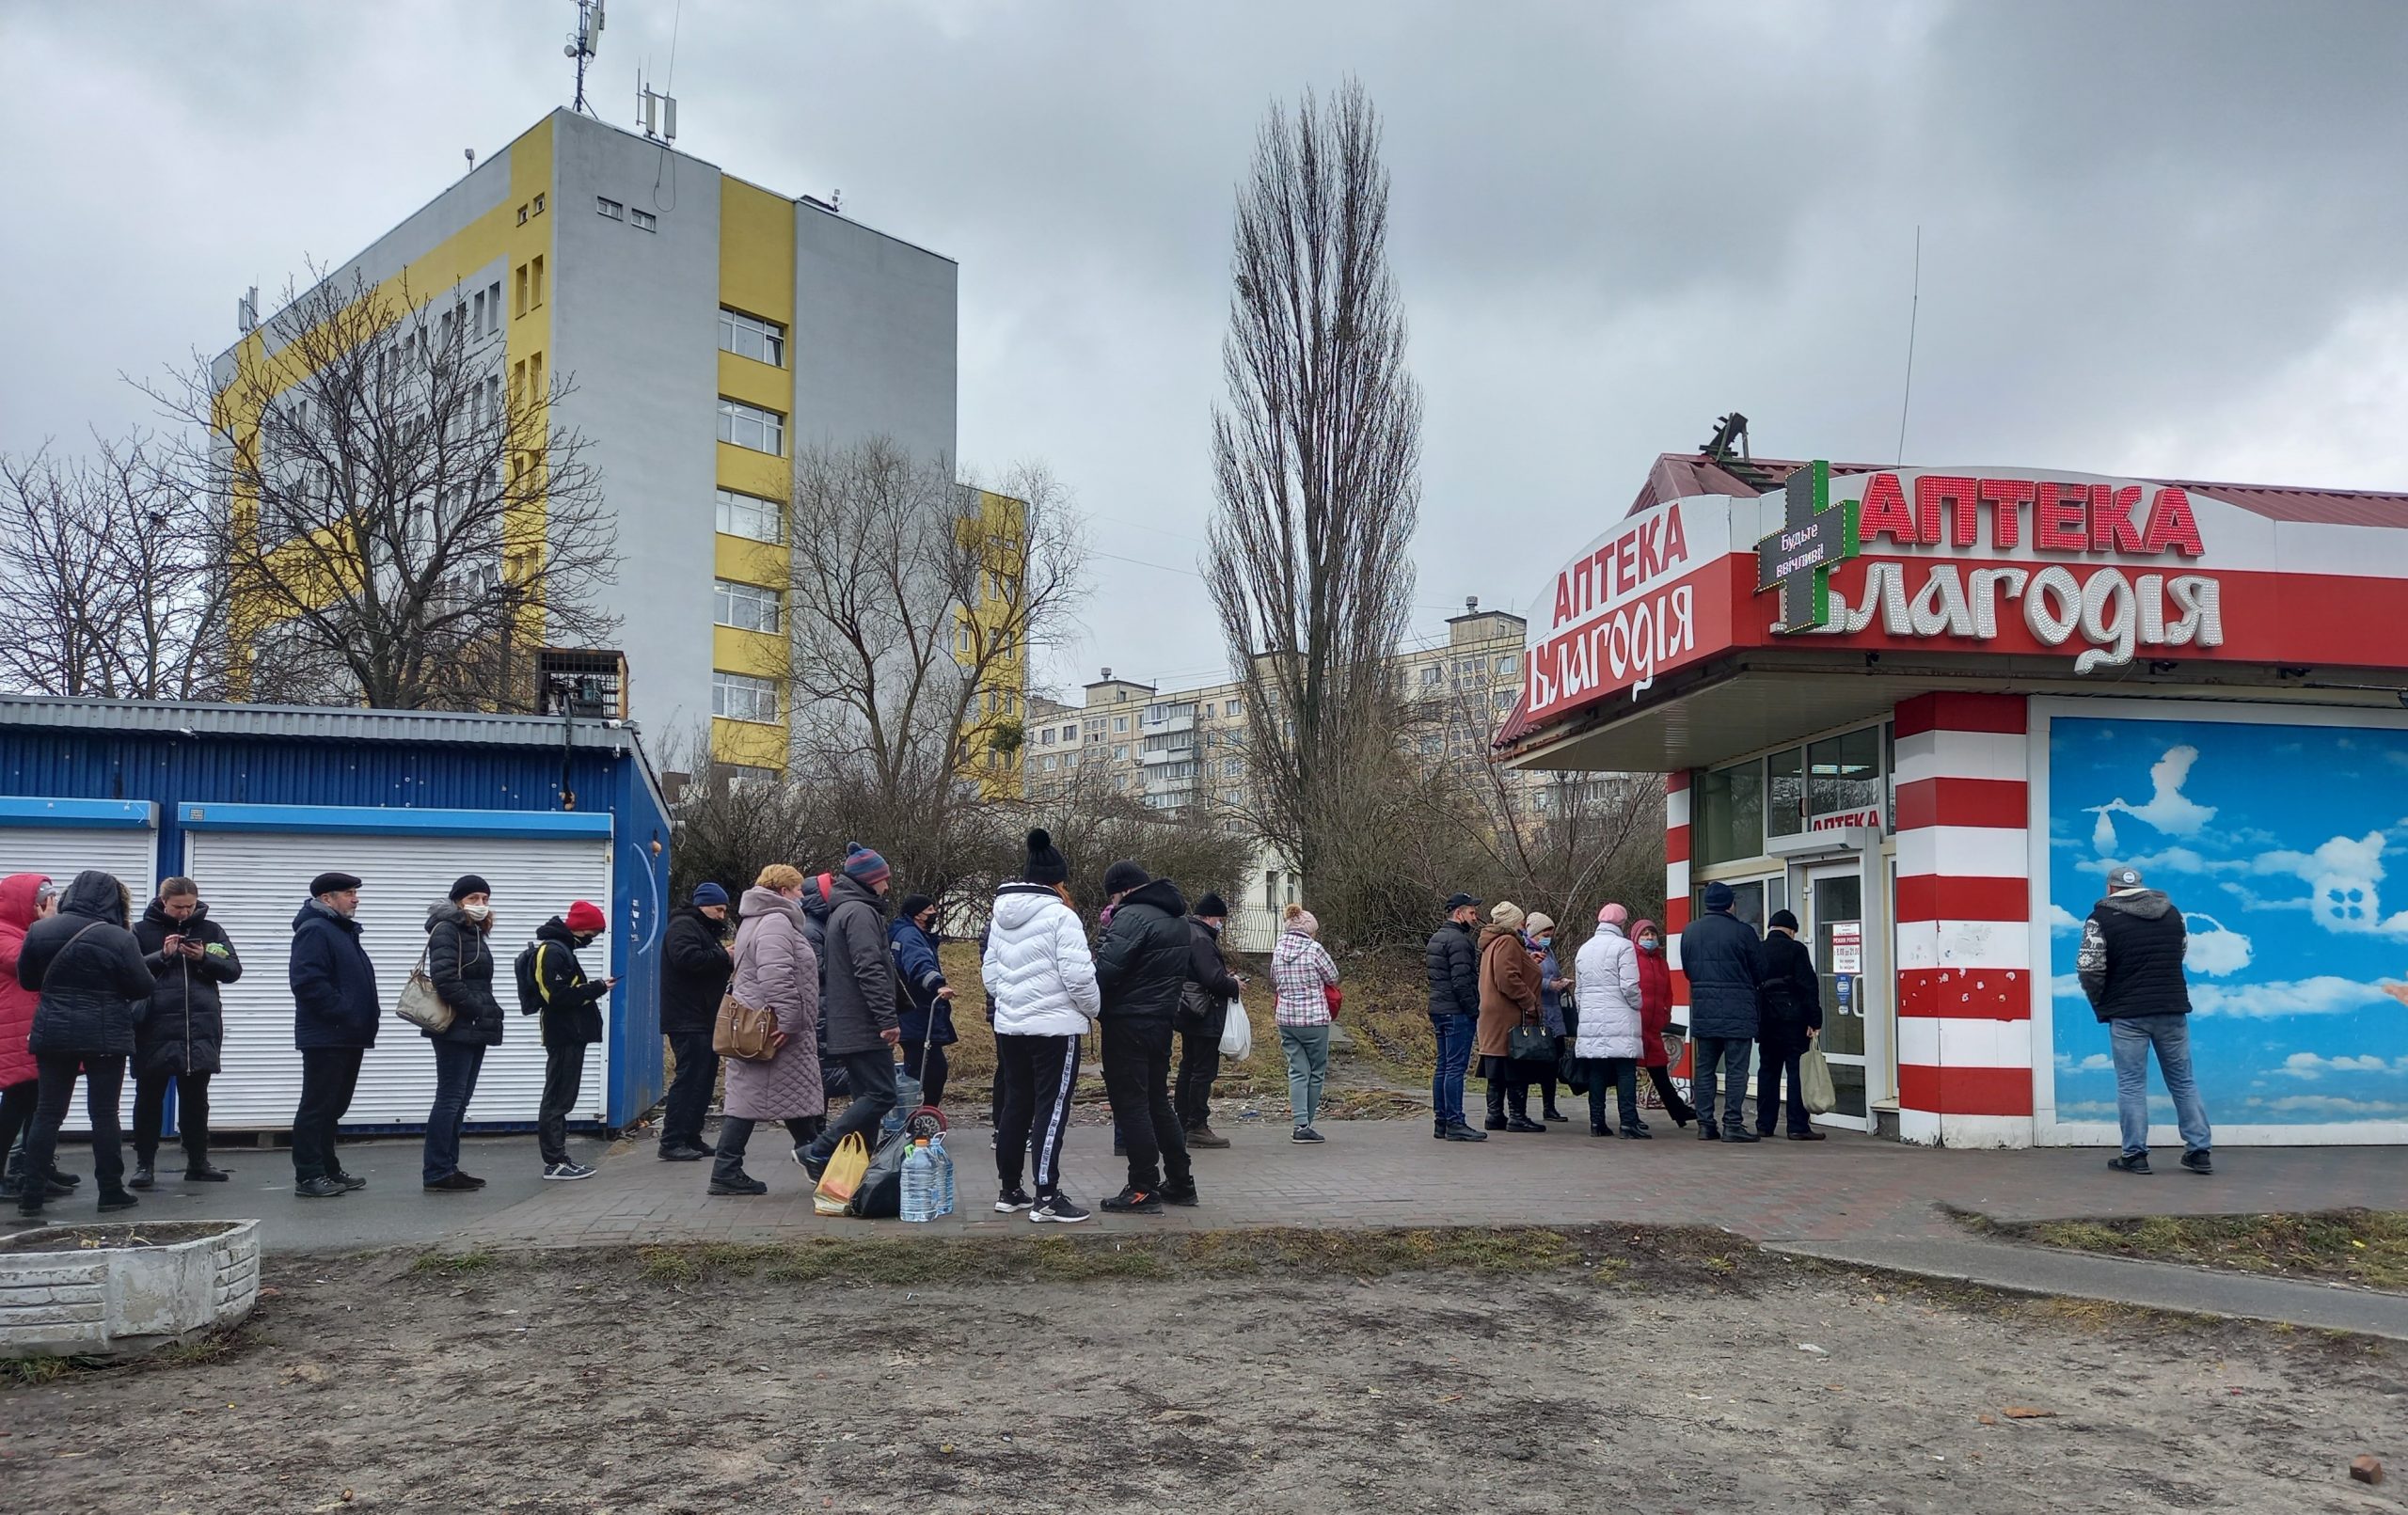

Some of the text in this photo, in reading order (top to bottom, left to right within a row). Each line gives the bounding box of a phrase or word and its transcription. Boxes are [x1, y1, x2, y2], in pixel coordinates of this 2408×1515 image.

[1781, 524, 1819, 552] Будьте
[1857, 472, 2205, 558] АПТЕКА
[1552, 503, 1688, 630] АПТЕКА
[1776, 543, 1825, 578] ввічливі!
[1527, 584, 1695, 714] Благодія
[1813, 810, 1879, 831] АПТЕКА
